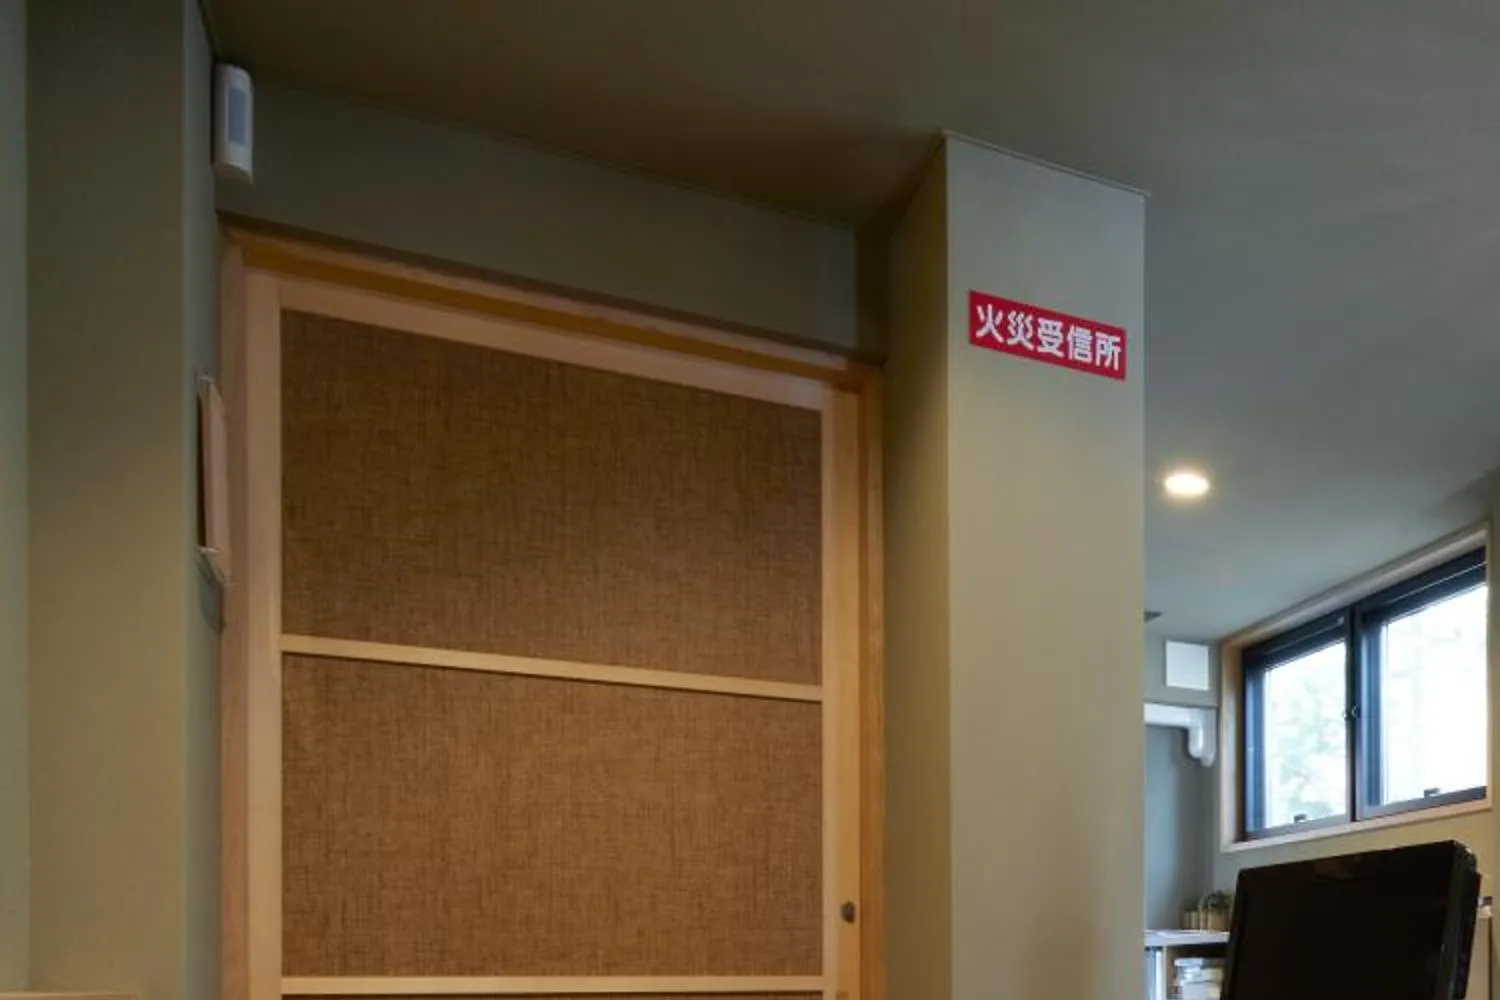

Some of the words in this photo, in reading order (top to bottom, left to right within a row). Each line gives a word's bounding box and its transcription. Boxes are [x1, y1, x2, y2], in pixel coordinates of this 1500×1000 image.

[975, 303, 1121, 371] 火災受信所
